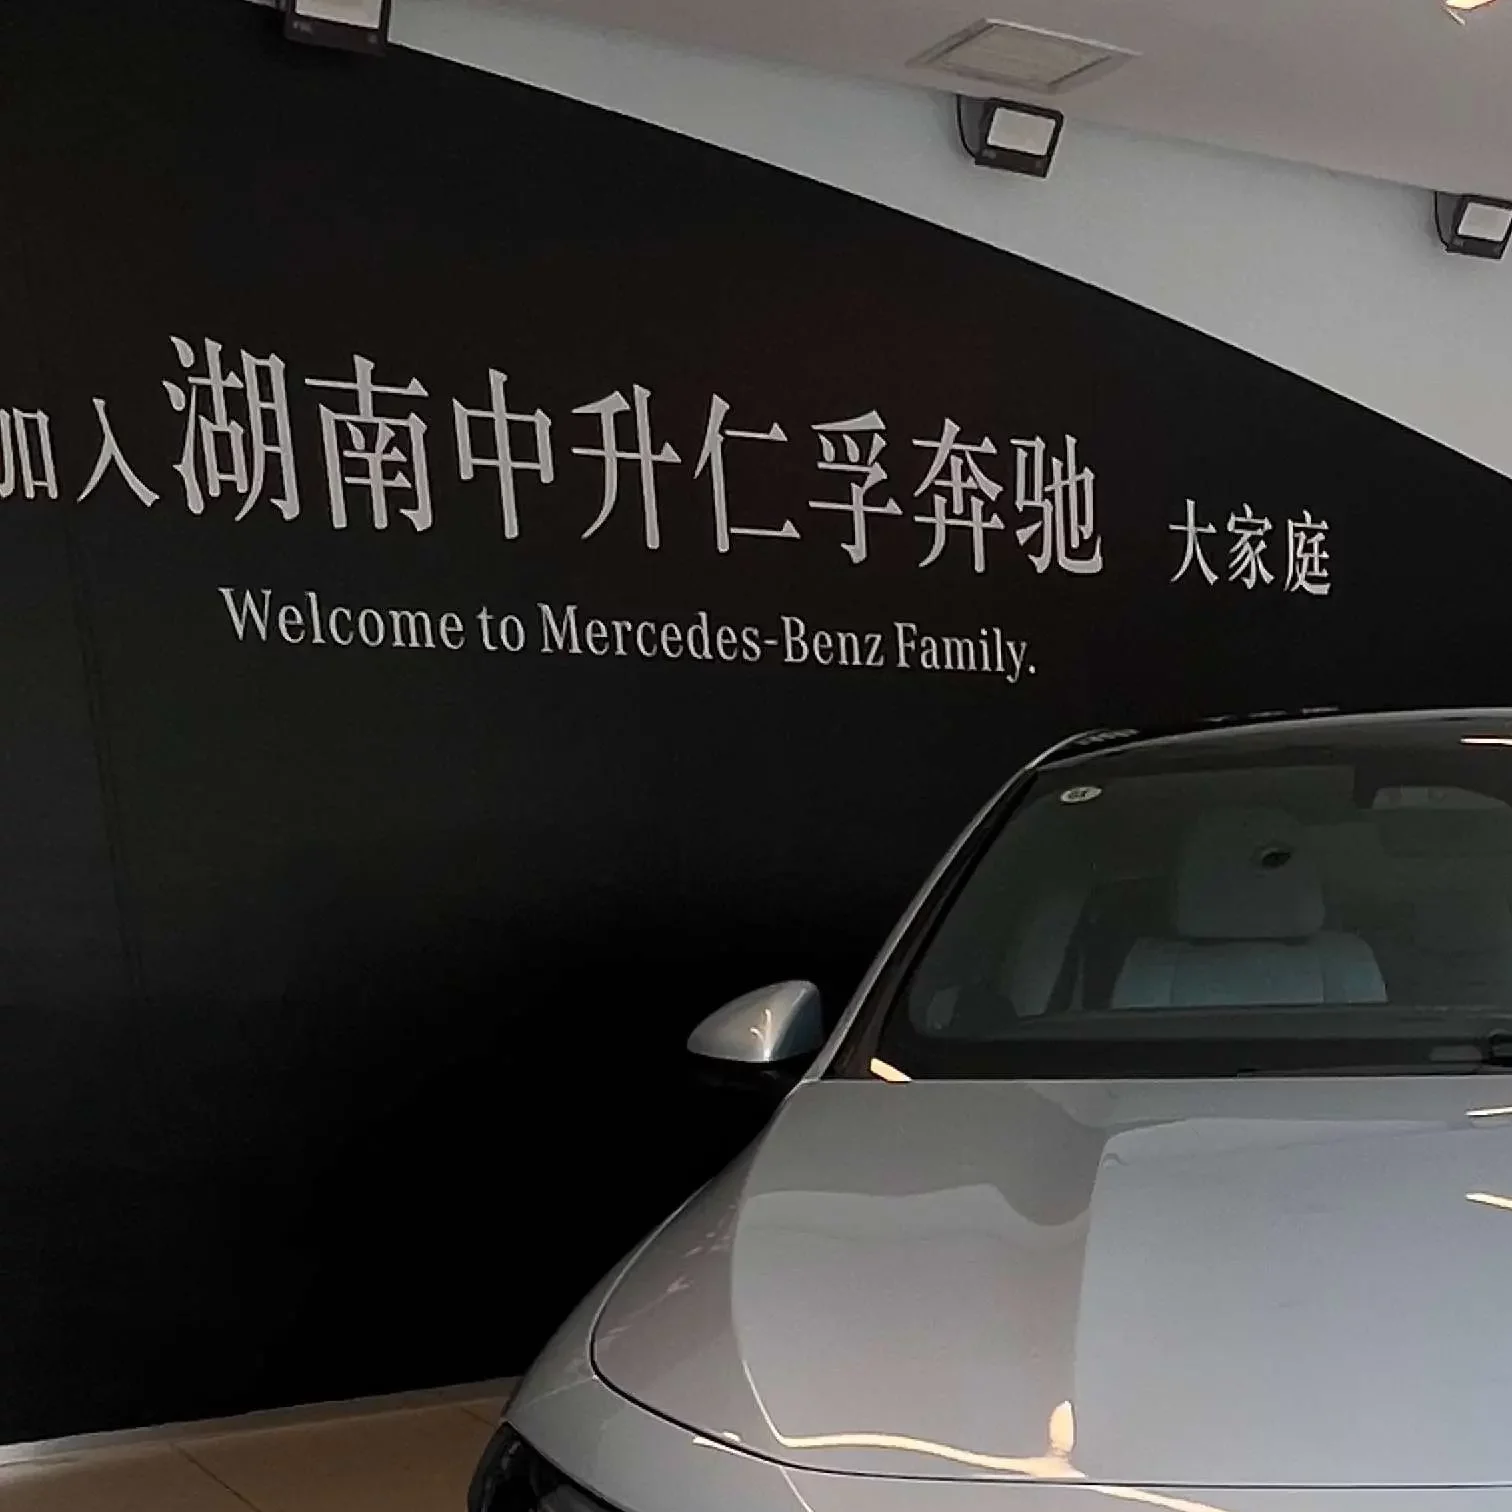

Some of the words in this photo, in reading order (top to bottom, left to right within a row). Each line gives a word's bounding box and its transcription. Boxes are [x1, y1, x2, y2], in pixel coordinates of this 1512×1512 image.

[0, 397, 160, 508] 加入
[162, 335, 1103, 574] 湖南中升仁孚奔驰
[1169, 498, 1331, 595] 大家庭
[218, 587, 464, 650] Welcome
[477, 606, 525, 652] to
[537, 603, 884, 666] Mercedes-Benz
[894, 622, 1036, 684] Family.
